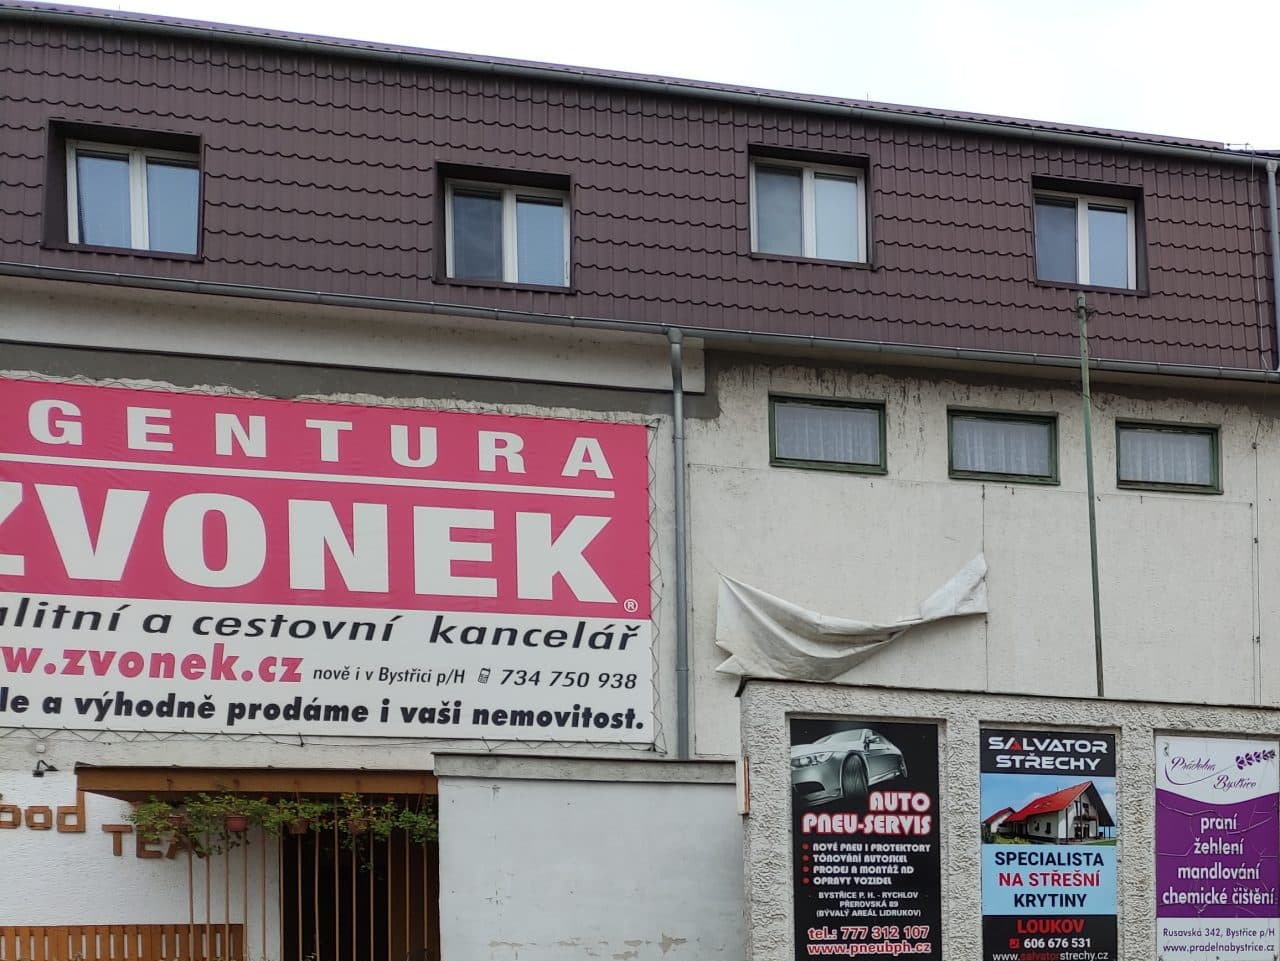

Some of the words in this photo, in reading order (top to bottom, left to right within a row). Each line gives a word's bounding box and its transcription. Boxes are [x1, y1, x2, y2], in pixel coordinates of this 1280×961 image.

[28, 399, 615, 480] GENTURA
[143, 613, 172, 634] a
[192, 614, 403, 642] cestovní
[429, 615, 642, 650] kancelář
[0, 642, 304, 683] w.zvonek.cz
[313, 665, 350, 681] nově
[355, 668, 361, 681] i
[366, 671, 373, 681] v
[379, 666, 432, 686] Bystřici
[436, 668, 465, 686] p/H
[500, 669, 540, 686] 734
[549, 671, 589, 687] 750
[598, 673, 637, 689] 938
[0, 686, 30, 714] le
[42, 696, 62, 714] a
[75, 690, 215, 722] výhodně
[227, 696, 369, 726] prodáme
[381, 698, 390, 723] i
[400, 700, 462, 725] vaši
[472, 704, 644, 730] nemovitost.
[988, 736, 1108, 754] SALVATOR
[995, 752, 1101, 771] STŘECHY
[869, 791, 931, 812] AUTO
[0, 789, 86, 833] ood
[803, 812, 931, 835] PNEU-SERVIS
[1200, 813, 1237, 833] praní
[812, 842, 838, 852] NOVÉ
[840, 843, 863, 852] PNEU
[864, 843, 869, 852] I
[870, 843, 931, 852] PROTEKTORY
[1193, 837, 1244, 855] žehlení
[864, 854, 908, 863] AUTOSKEL
[994, 851, 1105, 867] SPECIALISTA
[812, 865, 849, 874] PRODEJ
[851, 866, 858, 874] A
[860, 864, 899, 874] MONTÁŽ
[901, 866, 914, 874] ND
[1177, 862, 1261, 880] mandlování
[812, 876, 852, 885] OPRAVY
[854, 876, 892, 885] VOZIDEL
[999, 872, 1023, 887] NA
[1029, 869, 1101, 887] STŘEŠNÍ
[818, 890, 857, 899] BYSTŘICE
[882, 891, 919, 899] RYCHLOV
[1014, 893, 1087, 908] KRYTINY
[1162, 886, 1228, 905] chemické
[1232, 887, 1275, 905] čištění
[816, 909, 849, 917] (BÝVALÝ
[851, 908, 877, 917] AREÁL
[840, 900, 888, 908] PŘEROVSKÁ
[808, 926, 837, 940] tel.:
[841, 926, 868, 939] 777
[872, 925, 900, 939] 312
[904, 925, 929, 939] 107
[1017, 919, 1085, 933] LOUKOV
[1163, 927, 1202, 937] Rusavská
[1205, 928, 1223, 938] 342,
[1226, 927, 1257, 939] Bystřice
[1259, 928, 1275, 938] p/H
[807, 940, 931, 957] www.pneubph.cz
[1024, 938, 1045, 948] 606
[1047, 938, 1069, 948] 676
[1071, 938, 1091, 948] 531
